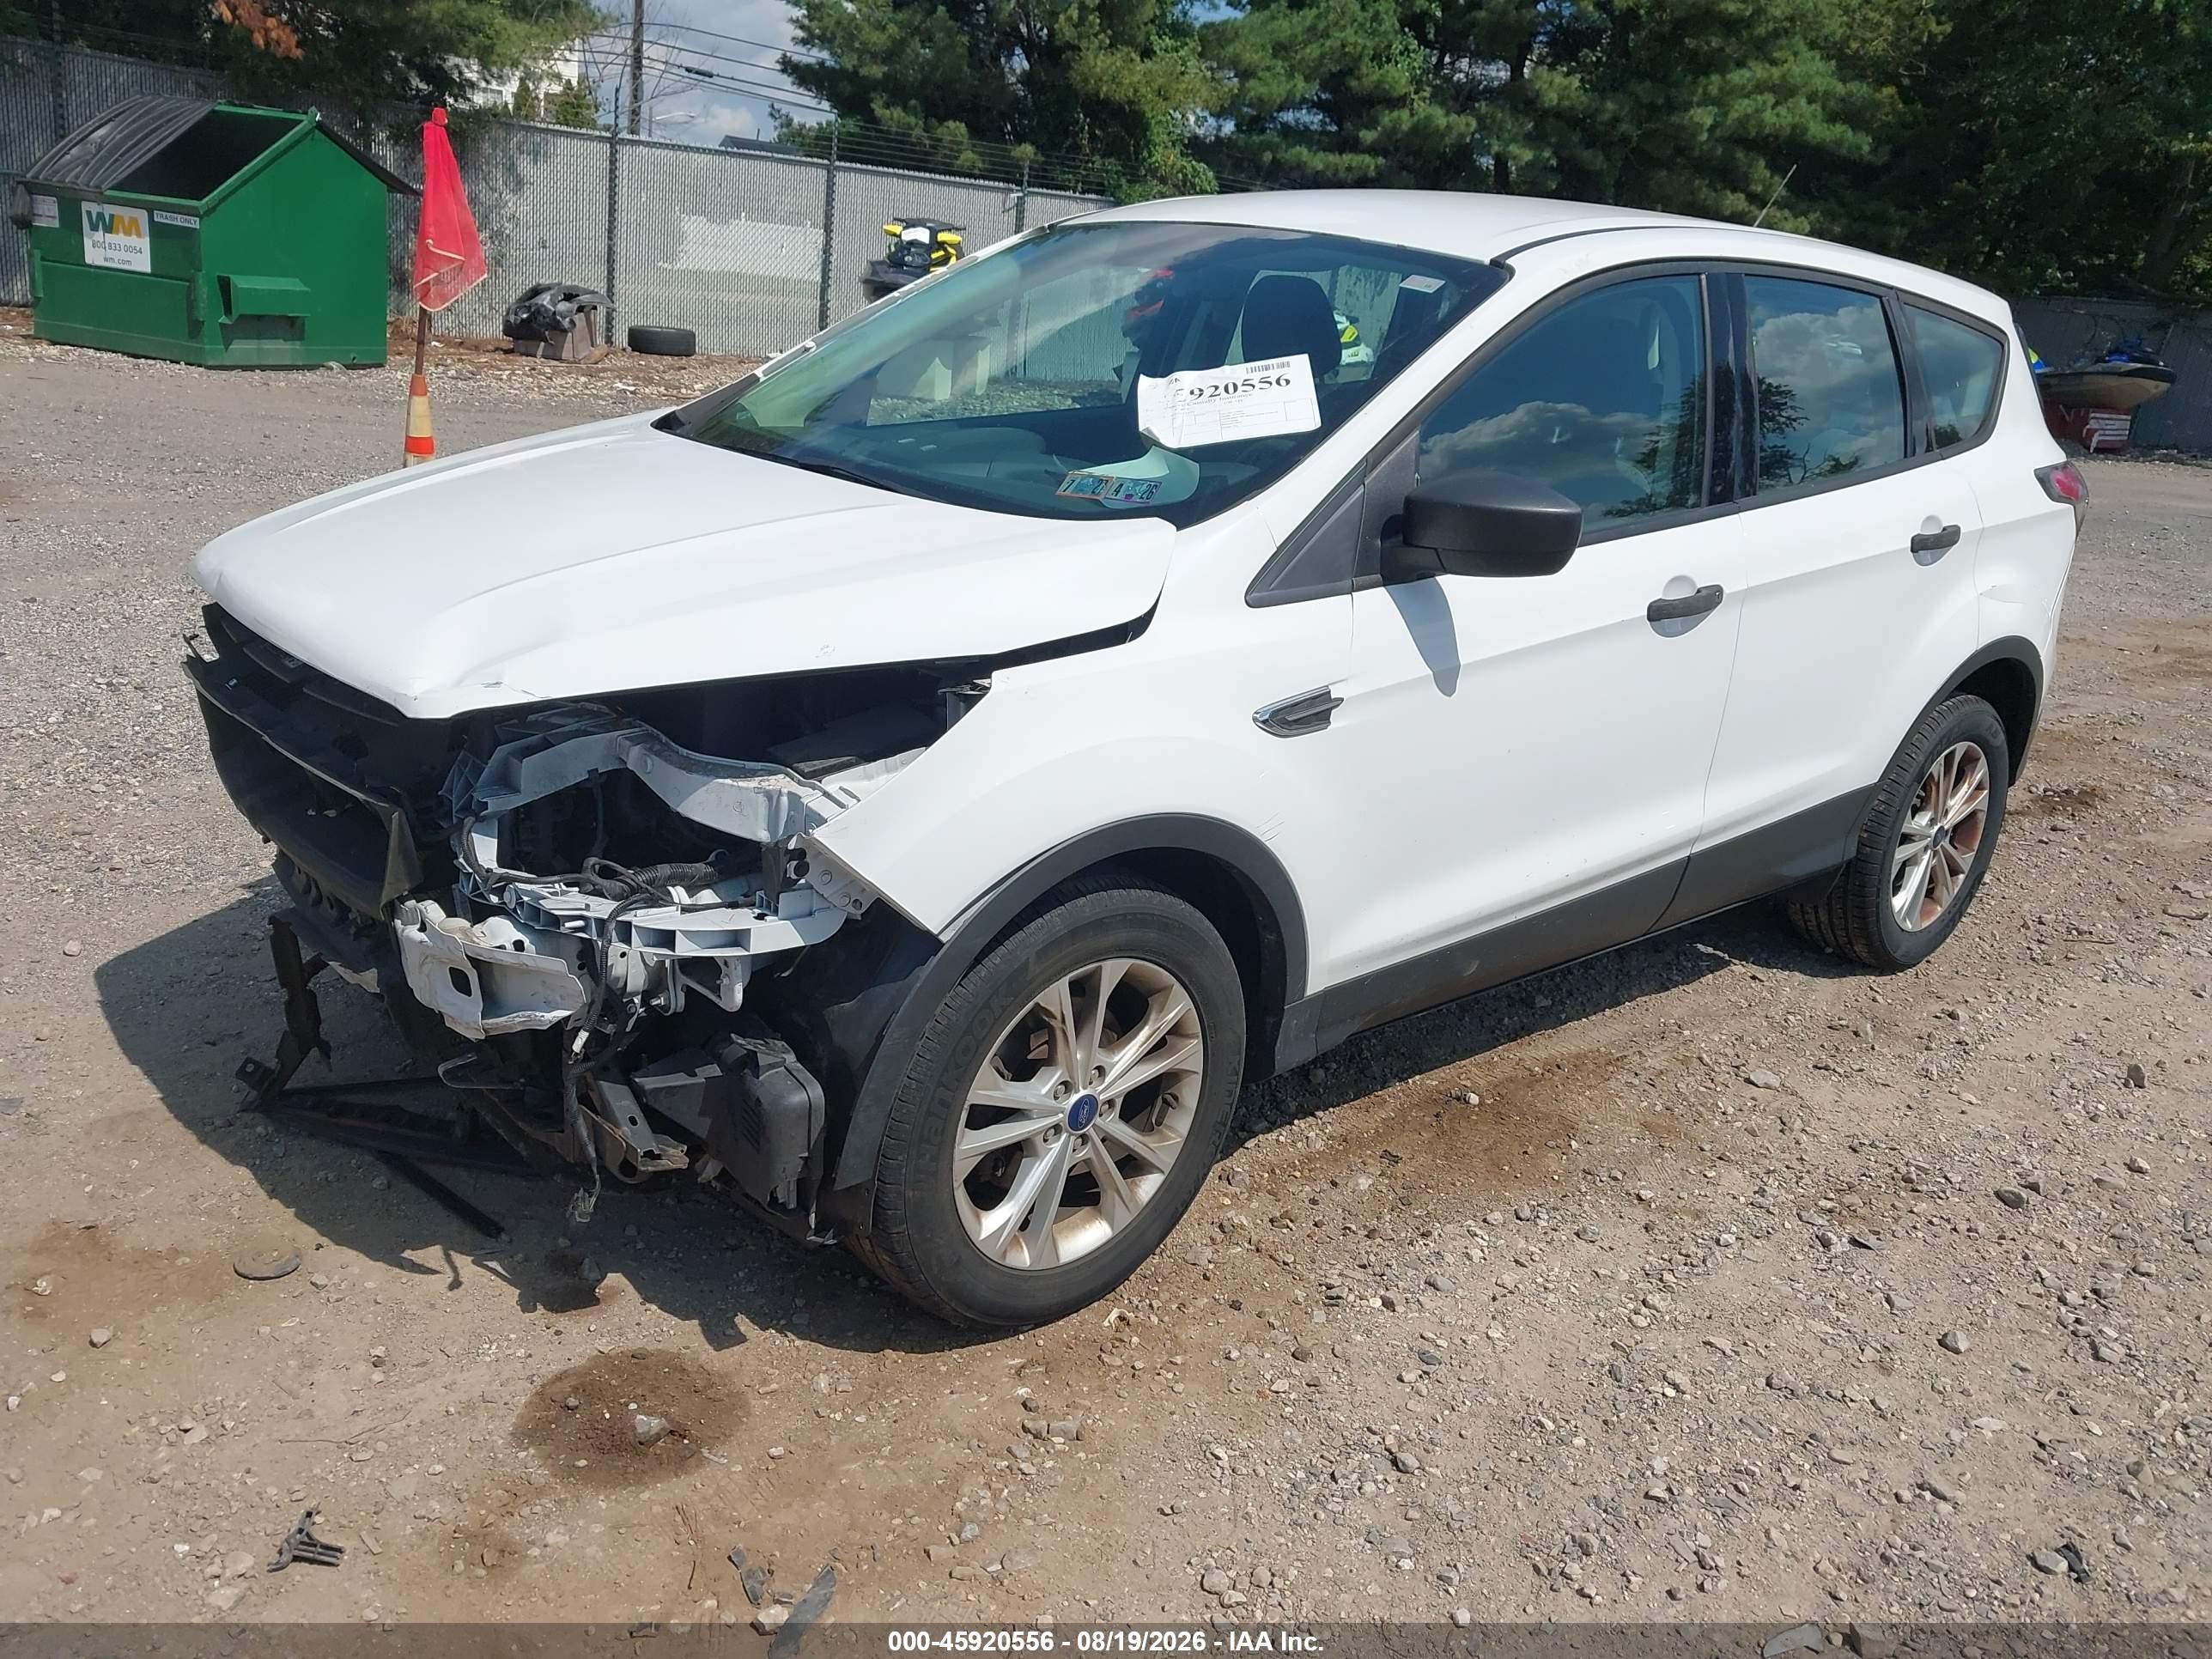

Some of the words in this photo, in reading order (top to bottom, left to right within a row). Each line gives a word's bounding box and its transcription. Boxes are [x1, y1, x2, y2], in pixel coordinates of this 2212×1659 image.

[86, 210, 143, 239] WM
[155, 214, 179, 223] TRASH
[179, 216, 198, 227] ONLY
[92, 240, 107, 251] 800
[108, 241, 122, 252] 833
[124, 243, 143, 255] 0054
[103, 256, 132, 267] wm.com
[1112, 483, 1124, 497] 4
